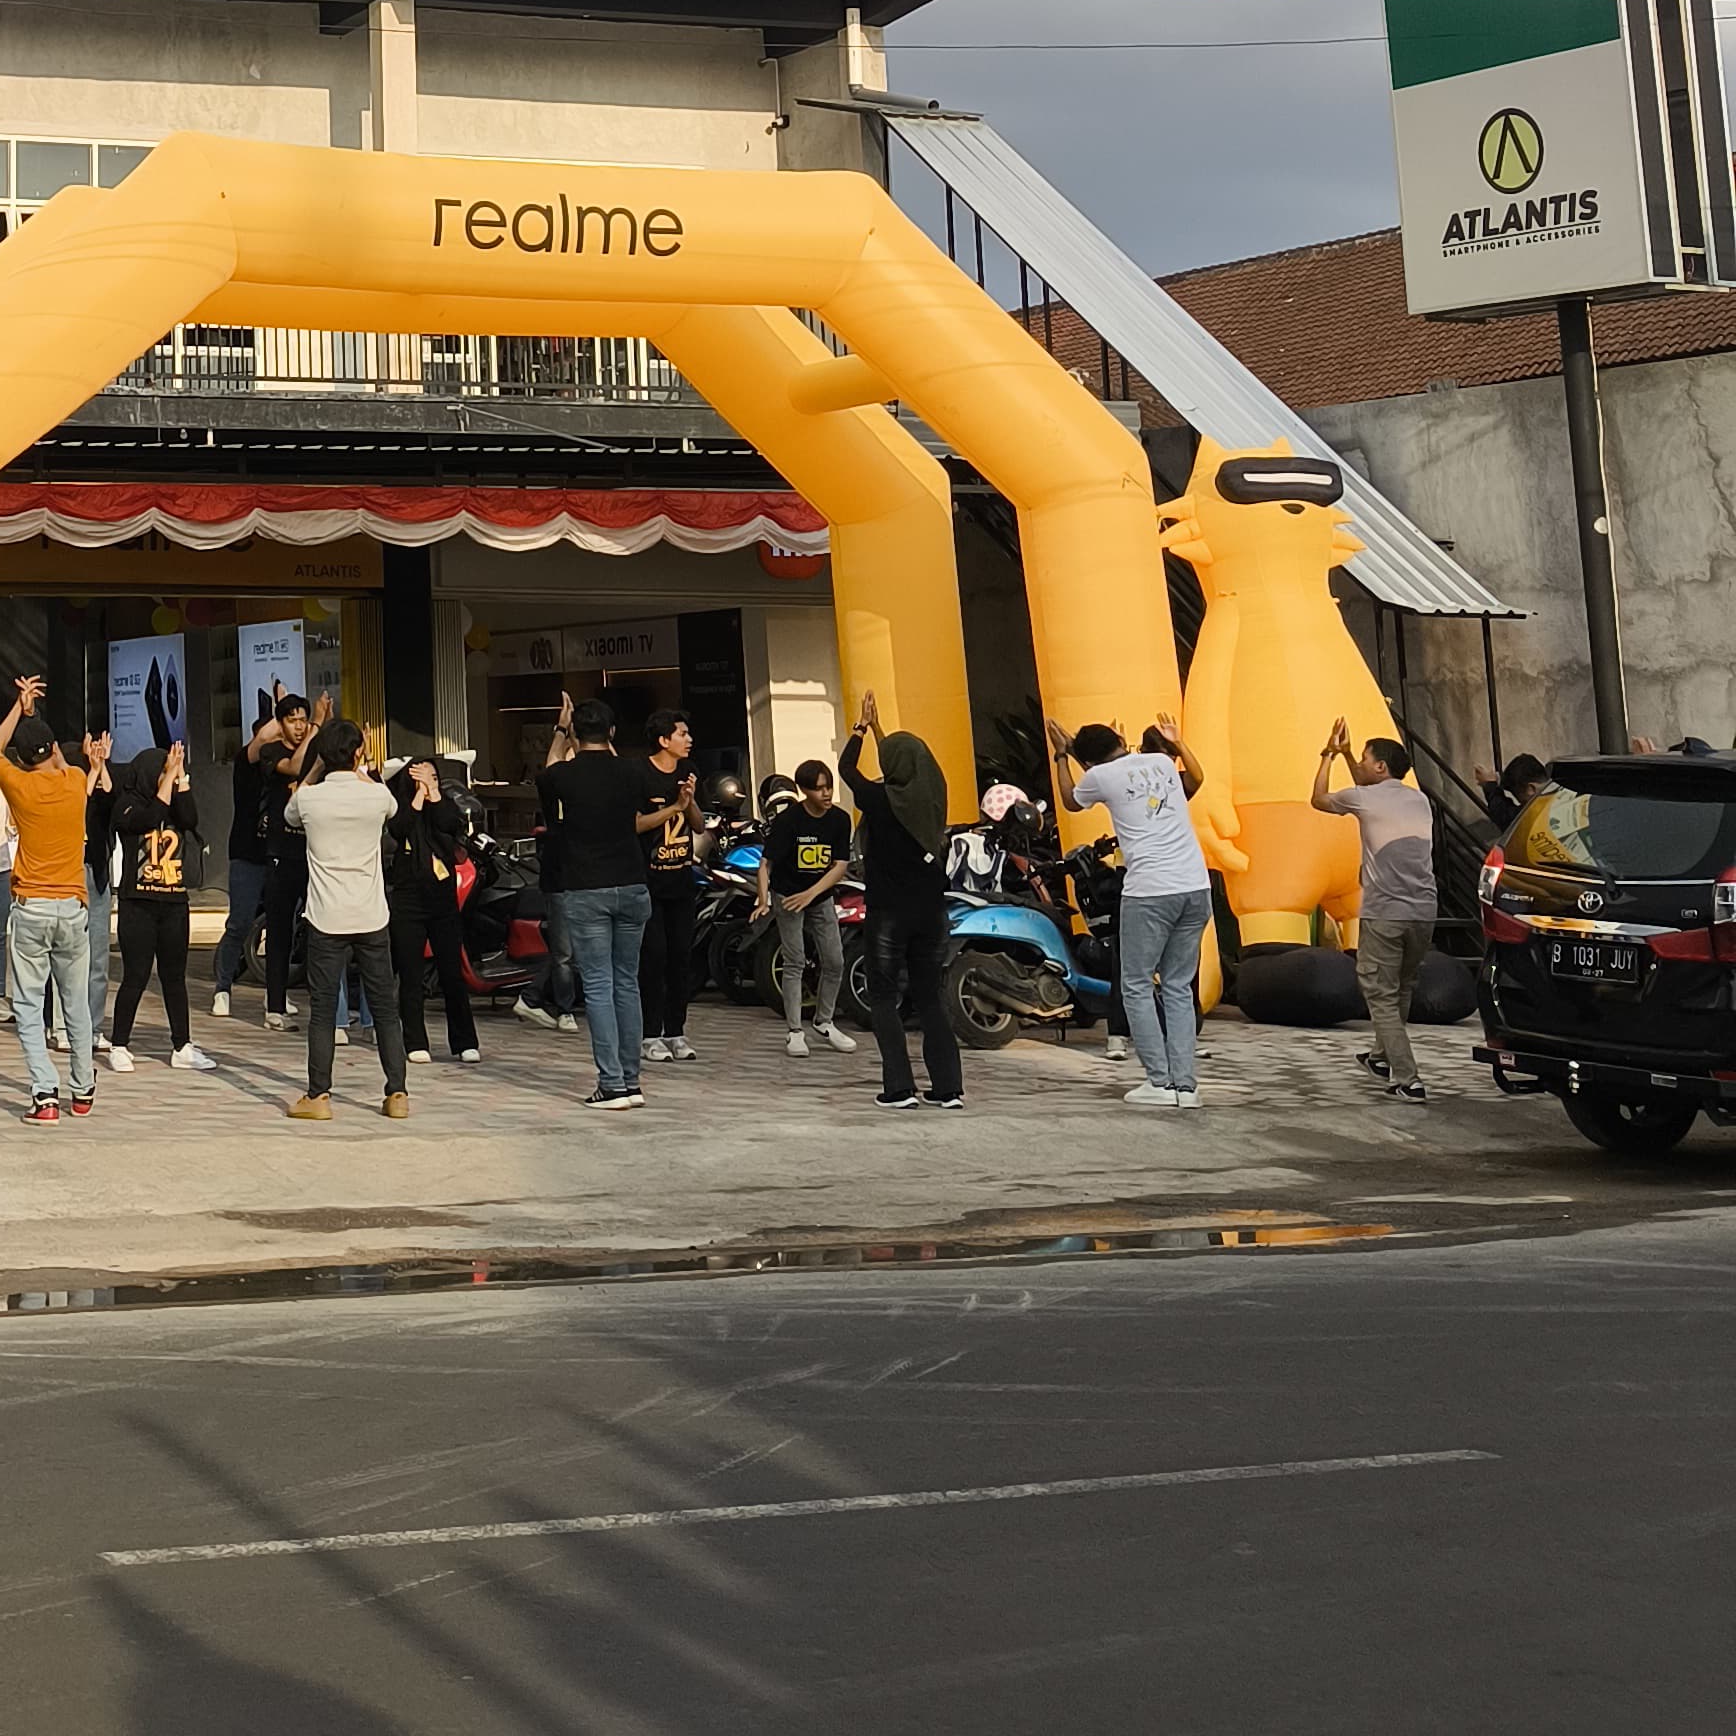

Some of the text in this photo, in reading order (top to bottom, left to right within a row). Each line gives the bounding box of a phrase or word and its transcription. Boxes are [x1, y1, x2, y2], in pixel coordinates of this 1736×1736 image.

[433, 193, 683, 257] realme
[1442, 190, 1598, 244] ATLANTIS
[1443, 240, 1510, 257] SMARTPHONE
[1526, 226, 1600, 244] ACCESSORIES
[294, 565, 361, 579] ATLANTIS
[639, 634, 653, 654] TV
[145, 829, 182, 866] 12
[1553, 944, 1634, 970] B 1031 JUY
